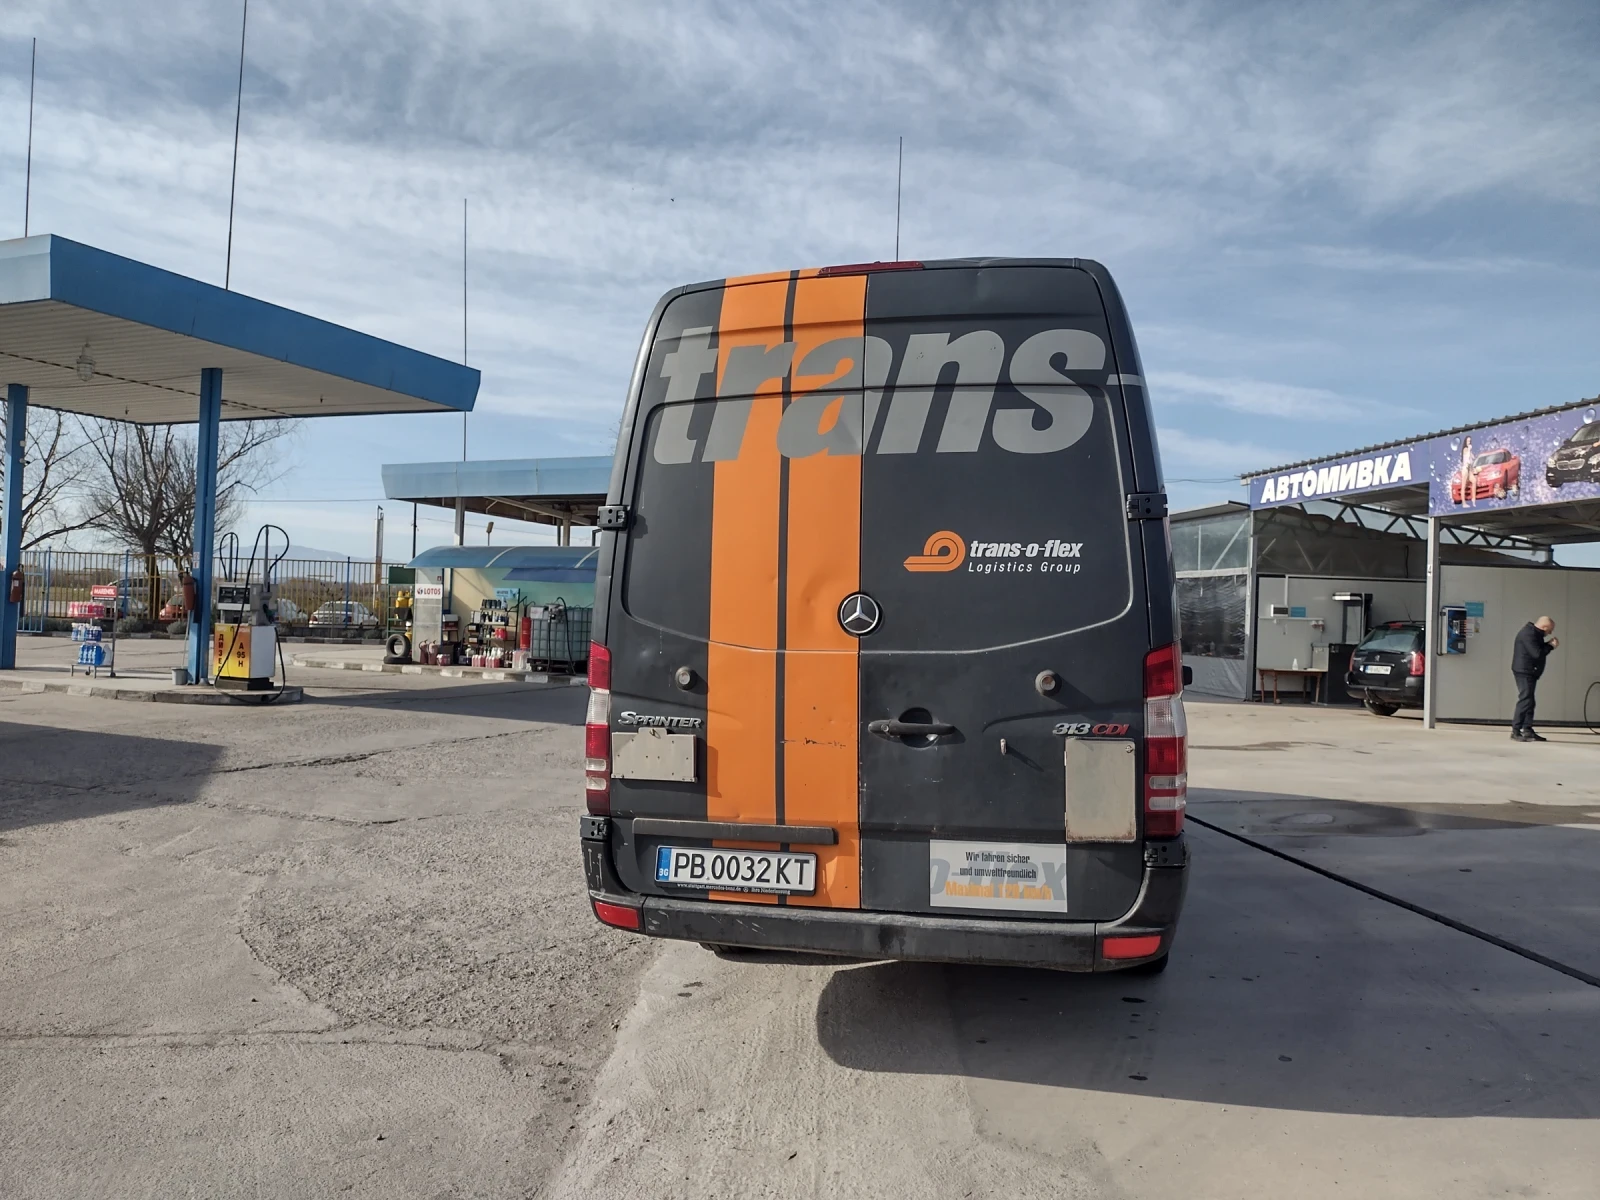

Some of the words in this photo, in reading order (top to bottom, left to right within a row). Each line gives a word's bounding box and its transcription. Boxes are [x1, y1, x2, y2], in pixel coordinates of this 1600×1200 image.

[1260, 451, 1412, 504] АВТОМИВКА
[969, 540, 1083, 558] trans-o-flex
[968, 562, 1033, 574] Logistics
[1040, 562, 1081, 574] Group
[423, 587, 441, 595] LOTOS
[1052, 722, 1091, 735] 313
[1092, 723, 1130, 735] CDI
[965, 851, 980, 862] Wir
[981, 852, 1005, 863] fahren
[1006, 854, 1031, 864] sicher
[959, 866, 973, 876] und
[974, 867, 1037, 879] umweltfreundlich
